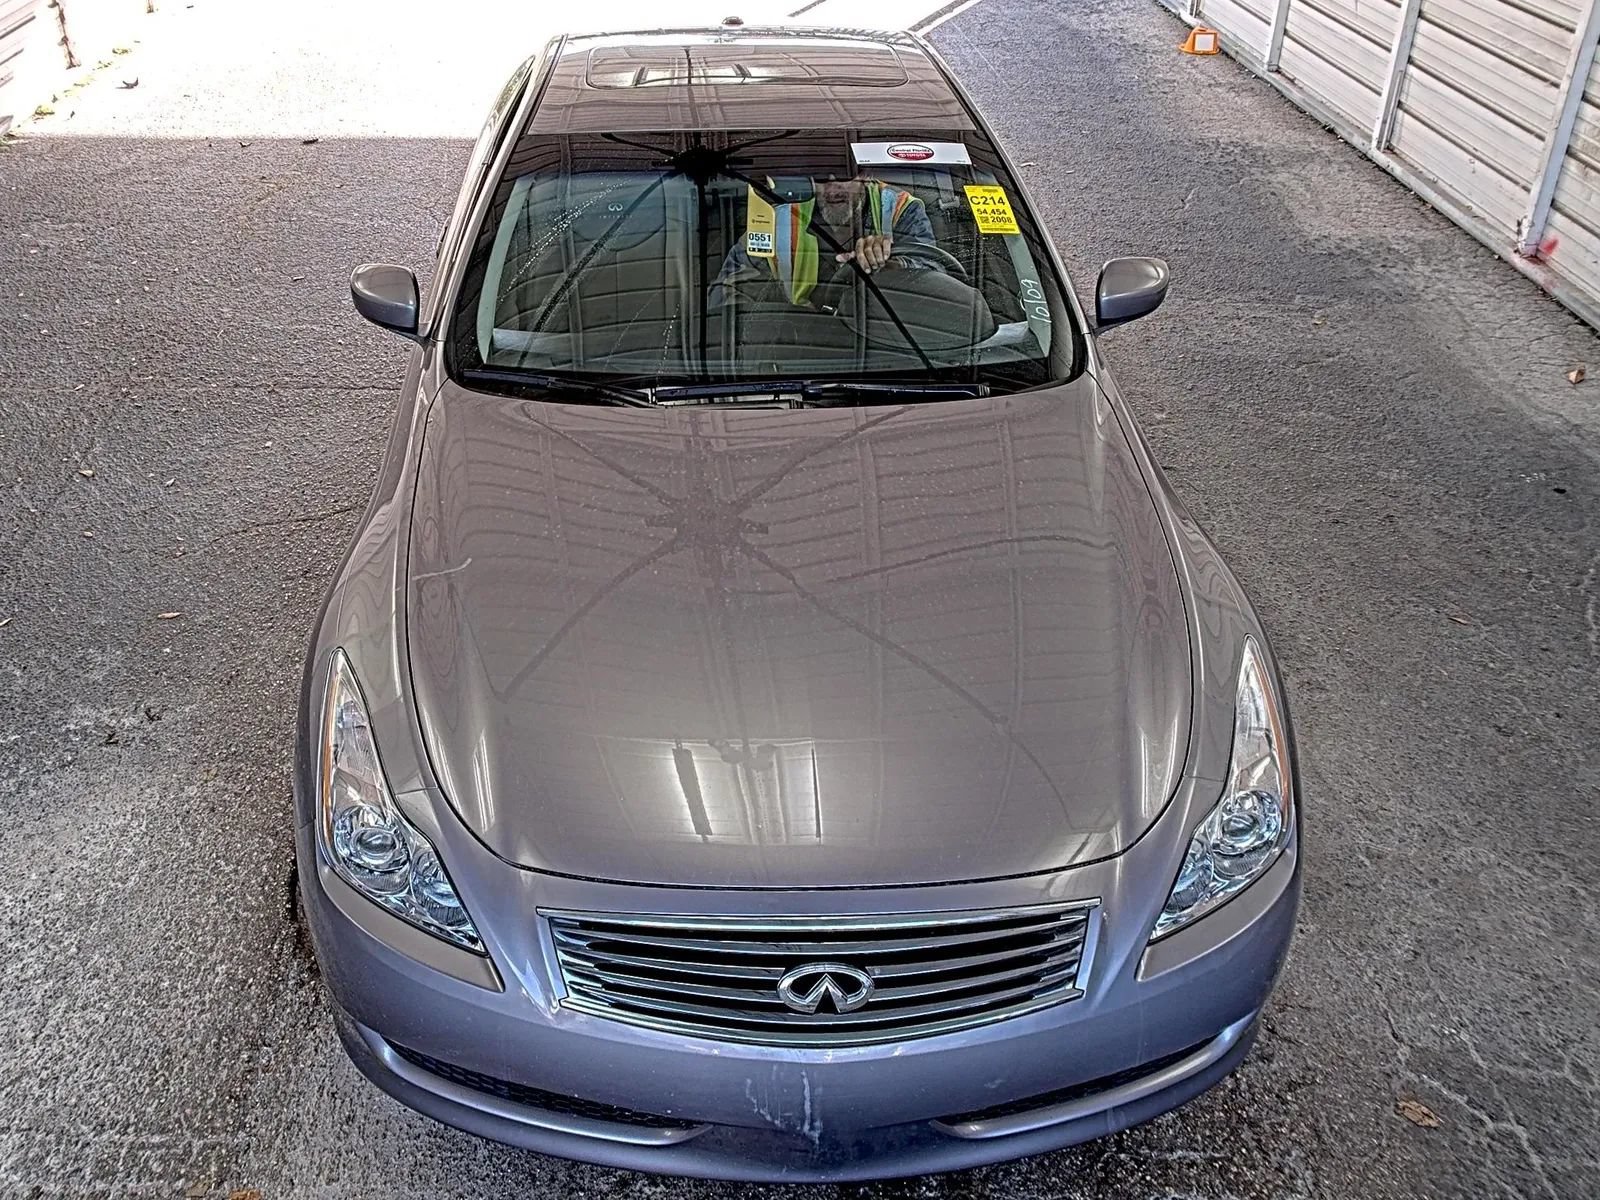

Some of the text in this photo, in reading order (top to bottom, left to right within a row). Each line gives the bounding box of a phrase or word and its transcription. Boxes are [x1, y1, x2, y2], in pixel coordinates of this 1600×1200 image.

[970, 195, 1006, 206] C214
[989, 215, 1013, 224] 2008
[748, 232, 771, 242] 0551
